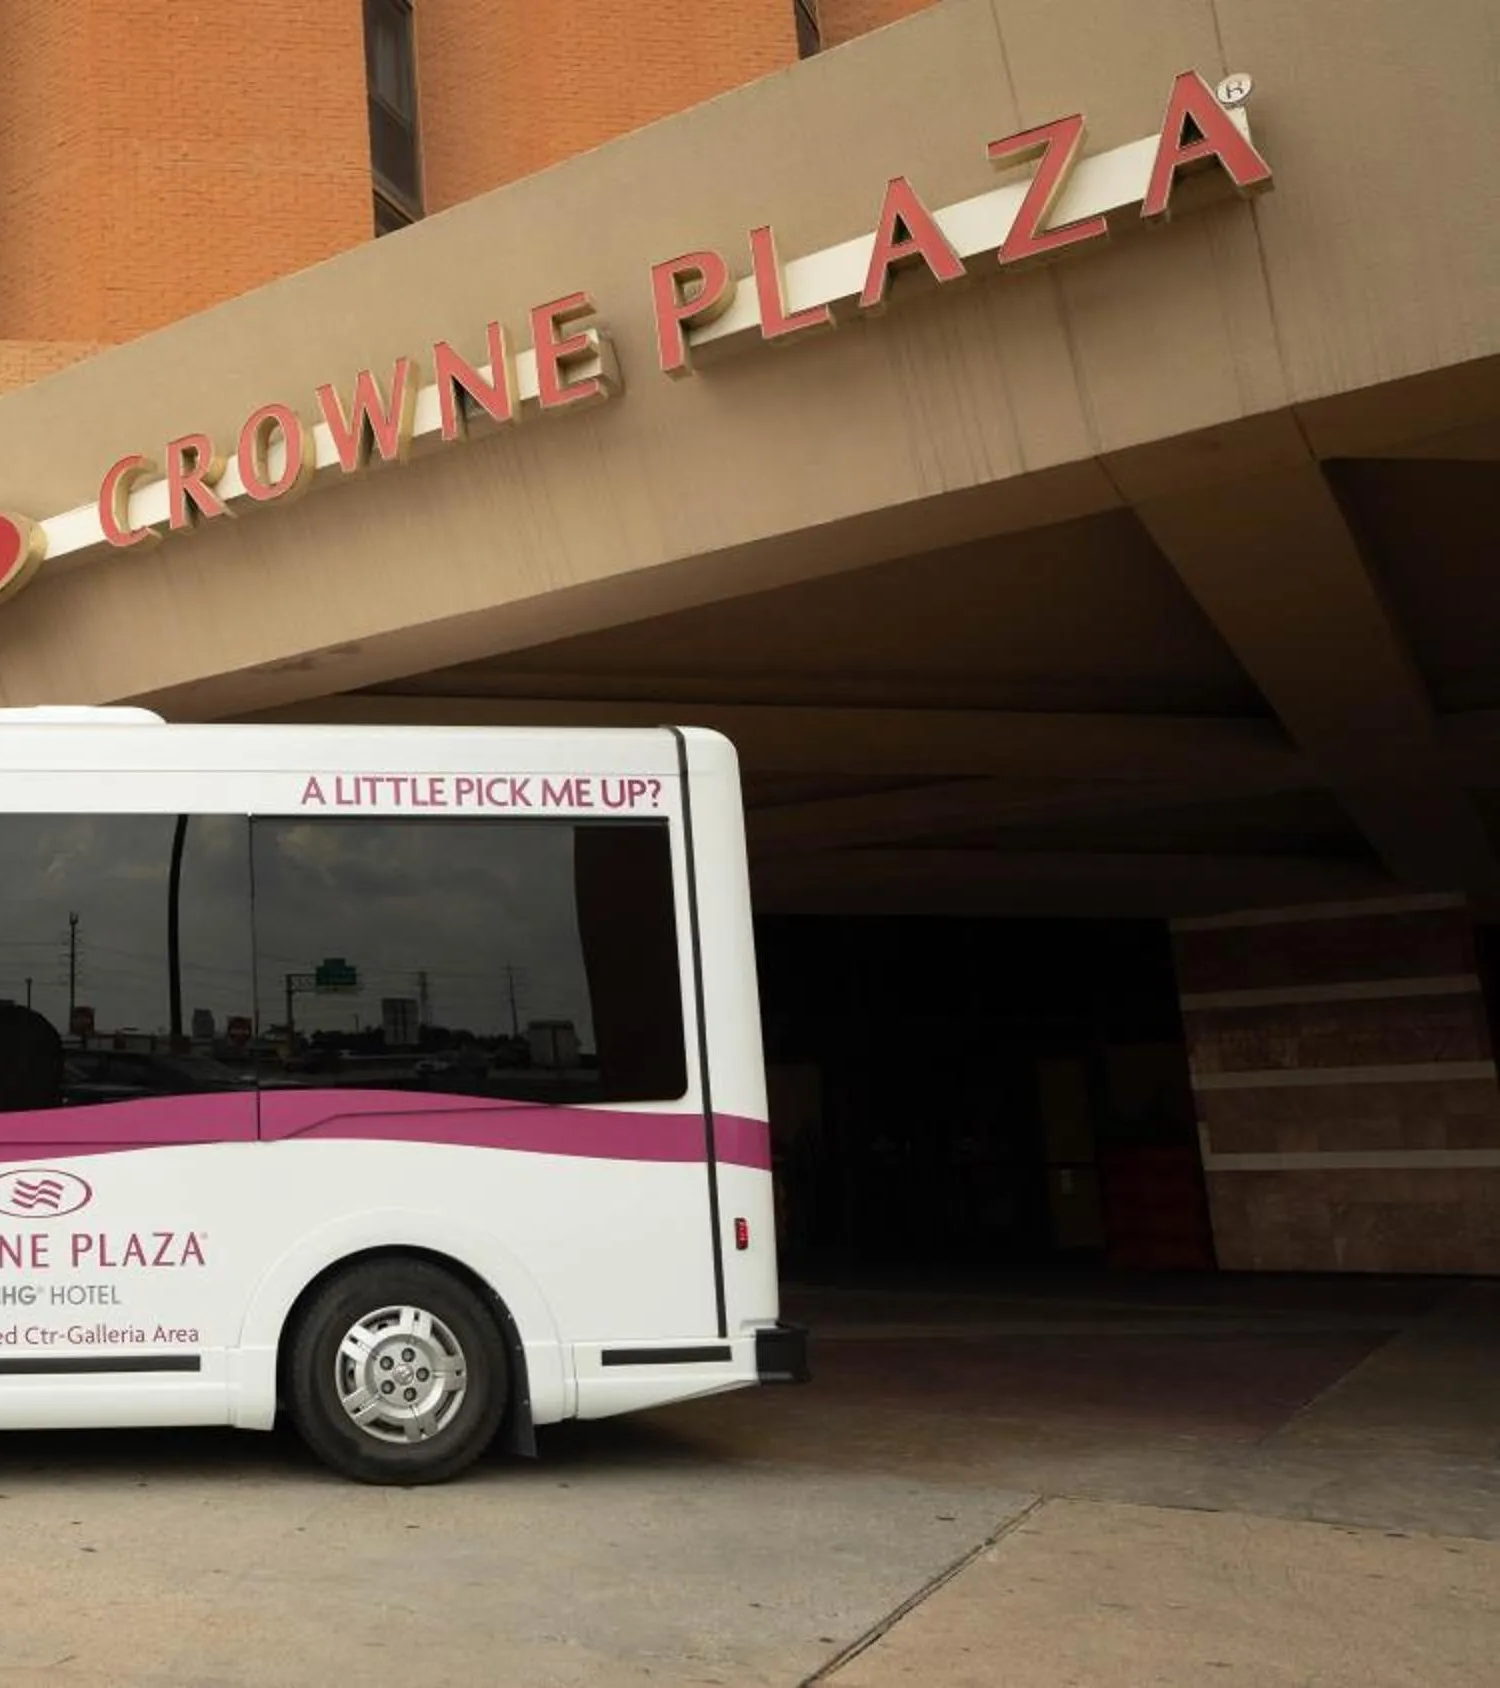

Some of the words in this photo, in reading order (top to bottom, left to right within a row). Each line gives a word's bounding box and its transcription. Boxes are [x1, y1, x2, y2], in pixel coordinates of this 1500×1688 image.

[99, 291, 605, 547] CROWNE
[302, 776, 327, 806] A
[335, 776, 448, 808] LITTLE
[454, 777, 534, 808] PICK
[541, 778, 595, 808] ME
[601, 778, 662, 809] UP?
[49, 1284, 123, 1306] HOTEL
[24, 1323, 147, 1346] Ctr-Galleria
[152, 1325, 200, 1344] Area
